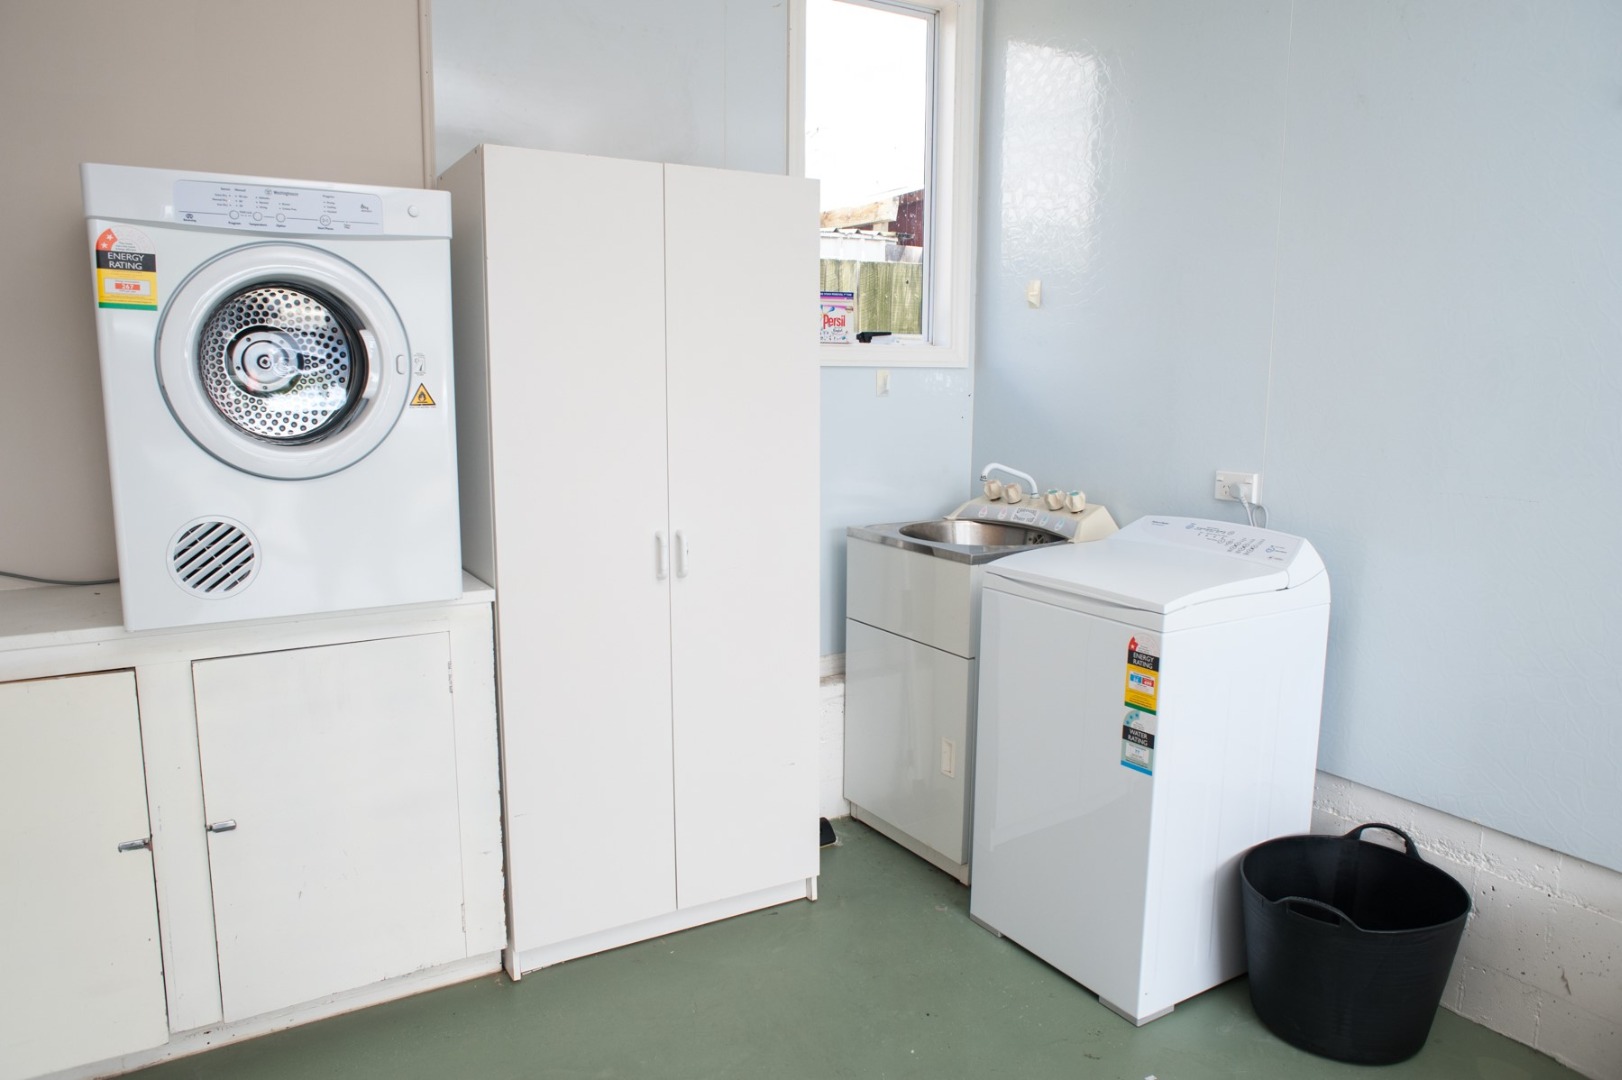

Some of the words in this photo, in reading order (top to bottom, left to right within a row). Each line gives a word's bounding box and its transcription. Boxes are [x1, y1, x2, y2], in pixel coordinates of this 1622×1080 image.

[107, 252, 145, 262] ENERGY
[109, 260, 143, 270] RATING
[823, 313, 846, 329] Persil
[1133, 652, 1155, 663] ENERGY
[1132, 658, 1153, 669] RATING
[1129, 728, 1148, 740] WATER
[1127, 734, 1149, 747] RATING
